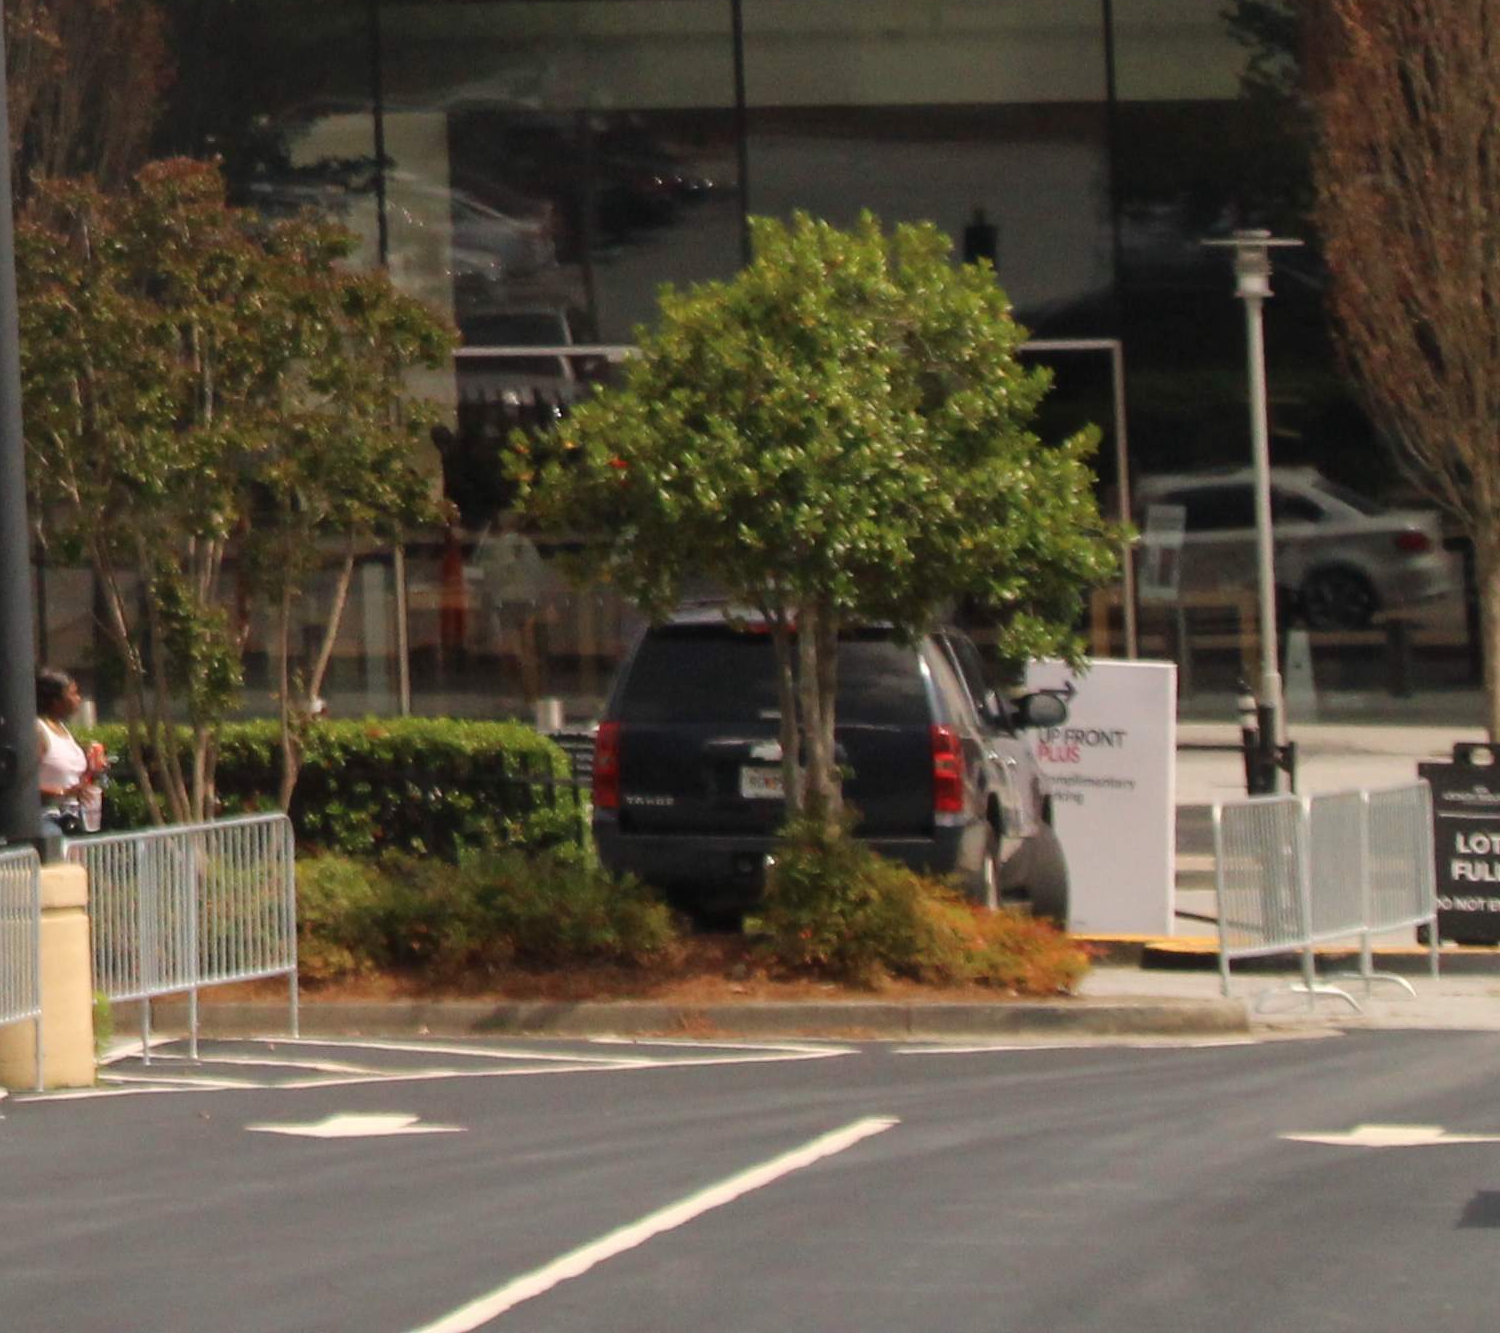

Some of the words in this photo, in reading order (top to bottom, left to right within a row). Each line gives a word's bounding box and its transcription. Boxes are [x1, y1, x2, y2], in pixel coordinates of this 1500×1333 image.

[1065, 729, 1127, 747] FRONT
[1037, 744, 1080, 763] PLUS
[1453, 896, 1486, 911] NOT
